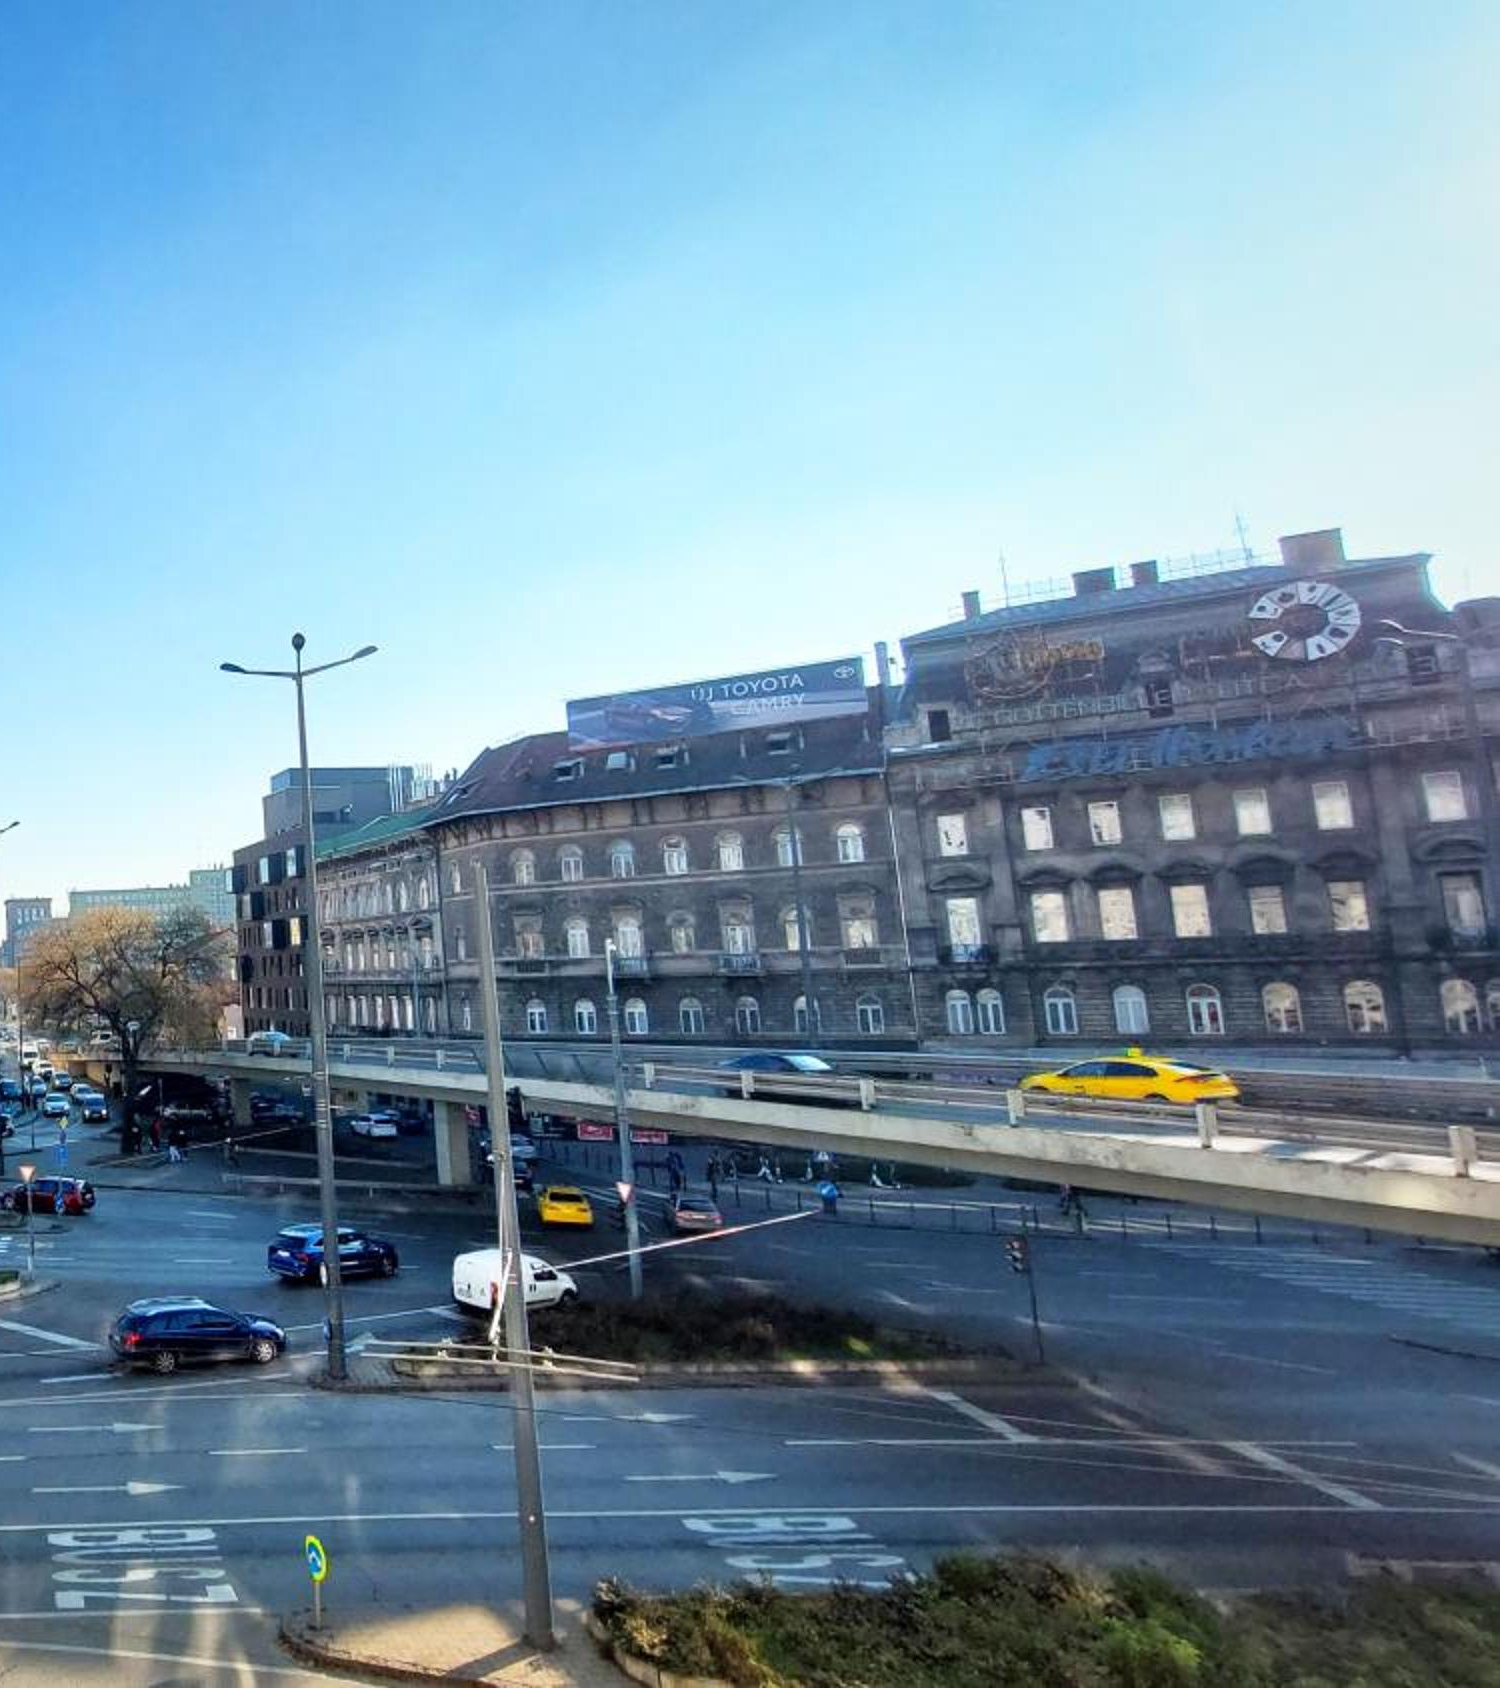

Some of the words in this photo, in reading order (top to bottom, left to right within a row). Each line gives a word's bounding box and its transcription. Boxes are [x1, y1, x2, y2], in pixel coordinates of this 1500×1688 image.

[721, 673, 804, 699] TOYOTA
[731, 693, 805, 716] CAMRY
[47, 1527, 240, 1609] BUSZ
